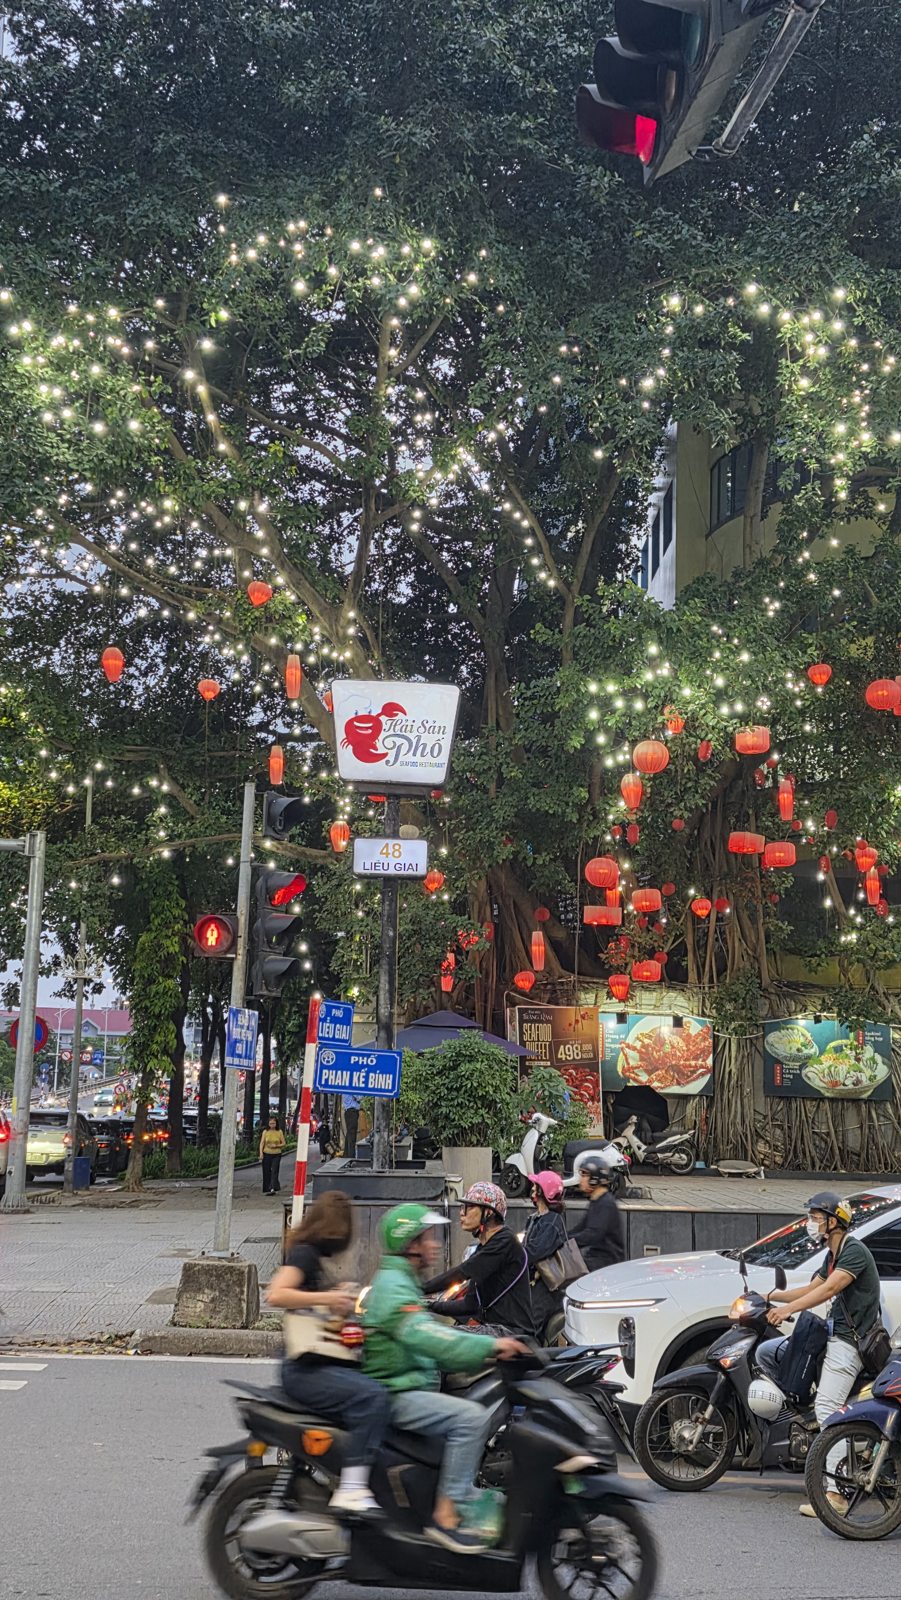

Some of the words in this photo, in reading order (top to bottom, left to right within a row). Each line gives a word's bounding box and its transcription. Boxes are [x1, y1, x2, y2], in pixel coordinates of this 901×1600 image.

[383, 718, 415, 733] Hải
[416, 719, 447, 735] Sản
[382, 734, 445, 767] Phố
[379, 842, 402, 859] 48
[393, 862, 418, 872] GIAI
[335, 1023, 350, 1041] GIAI
[523, 1023, 552, 1042] SEAFOOD
[350, 1054, 378, 1066] PHỐ
[557, 1044, 582, 1061] 498
[321, 1069, 350, 1087] PHAN
[352, 1067, 368, 1088] KẾ
[368, 1070, 393, 1090] BÍNH
